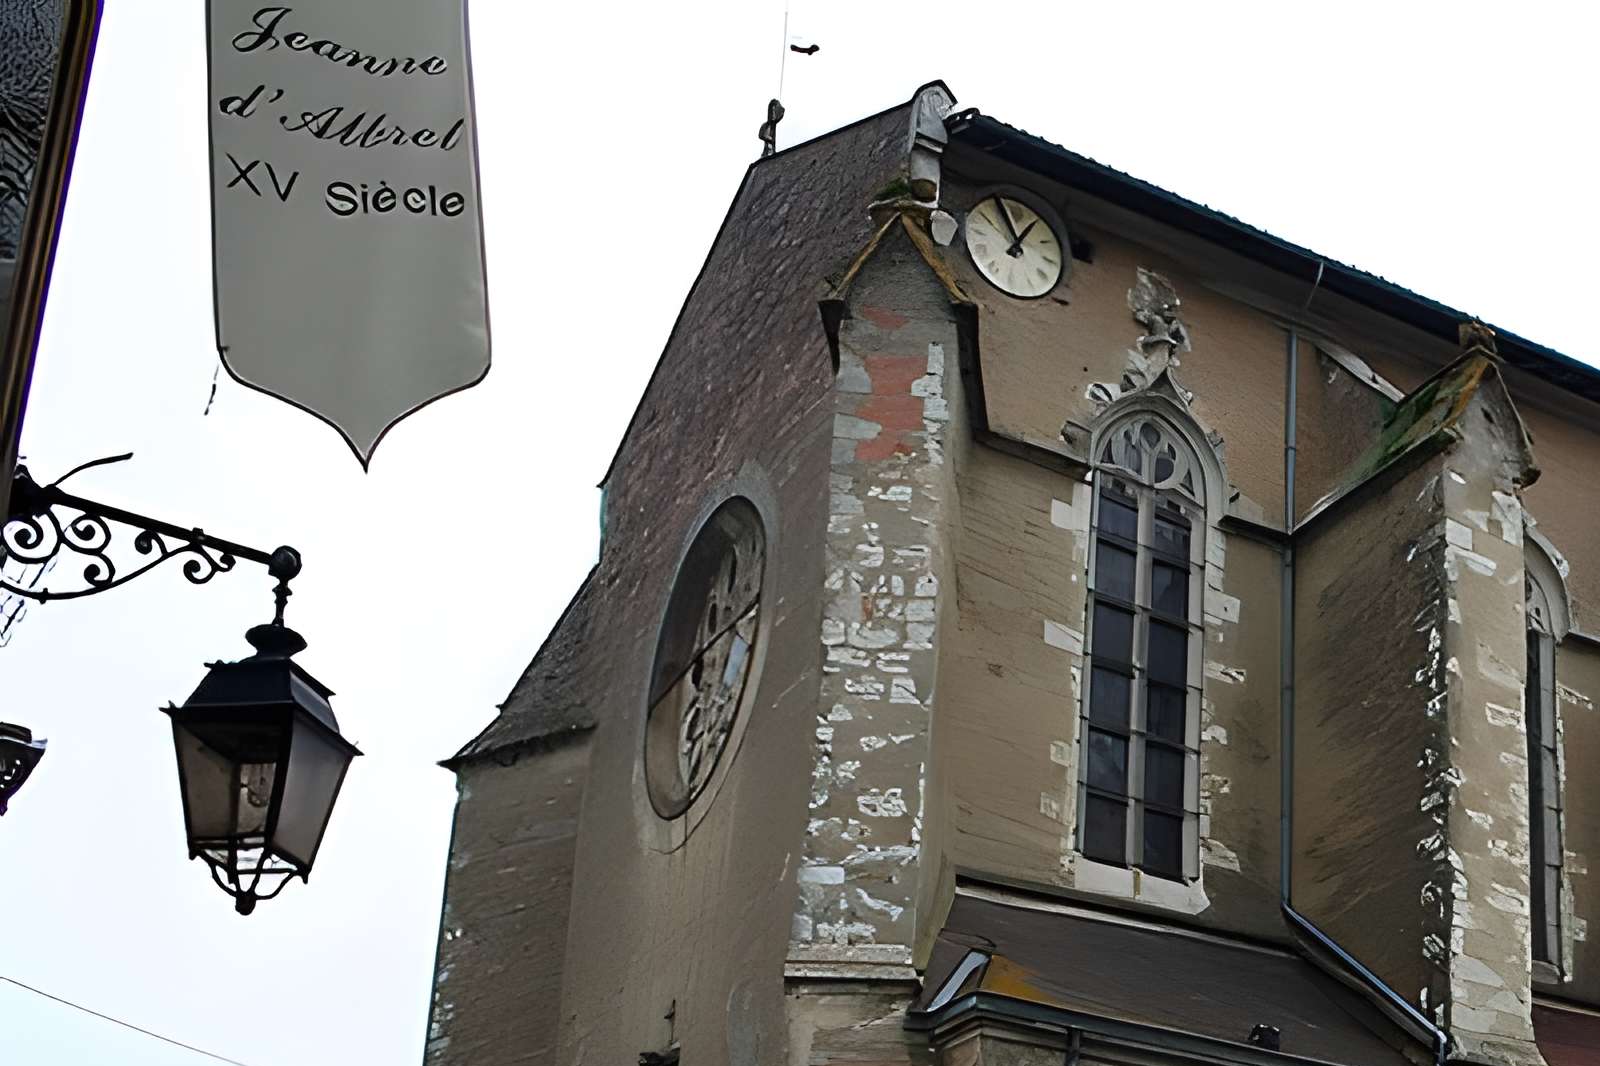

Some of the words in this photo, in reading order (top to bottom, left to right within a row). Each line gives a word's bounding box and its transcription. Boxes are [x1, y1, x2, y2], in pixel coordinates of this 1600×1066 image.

[232, 7, 447, 75] Jeanne
[226, 152, 299, 202] XV
[325, 180, 465, 217] Siècle
